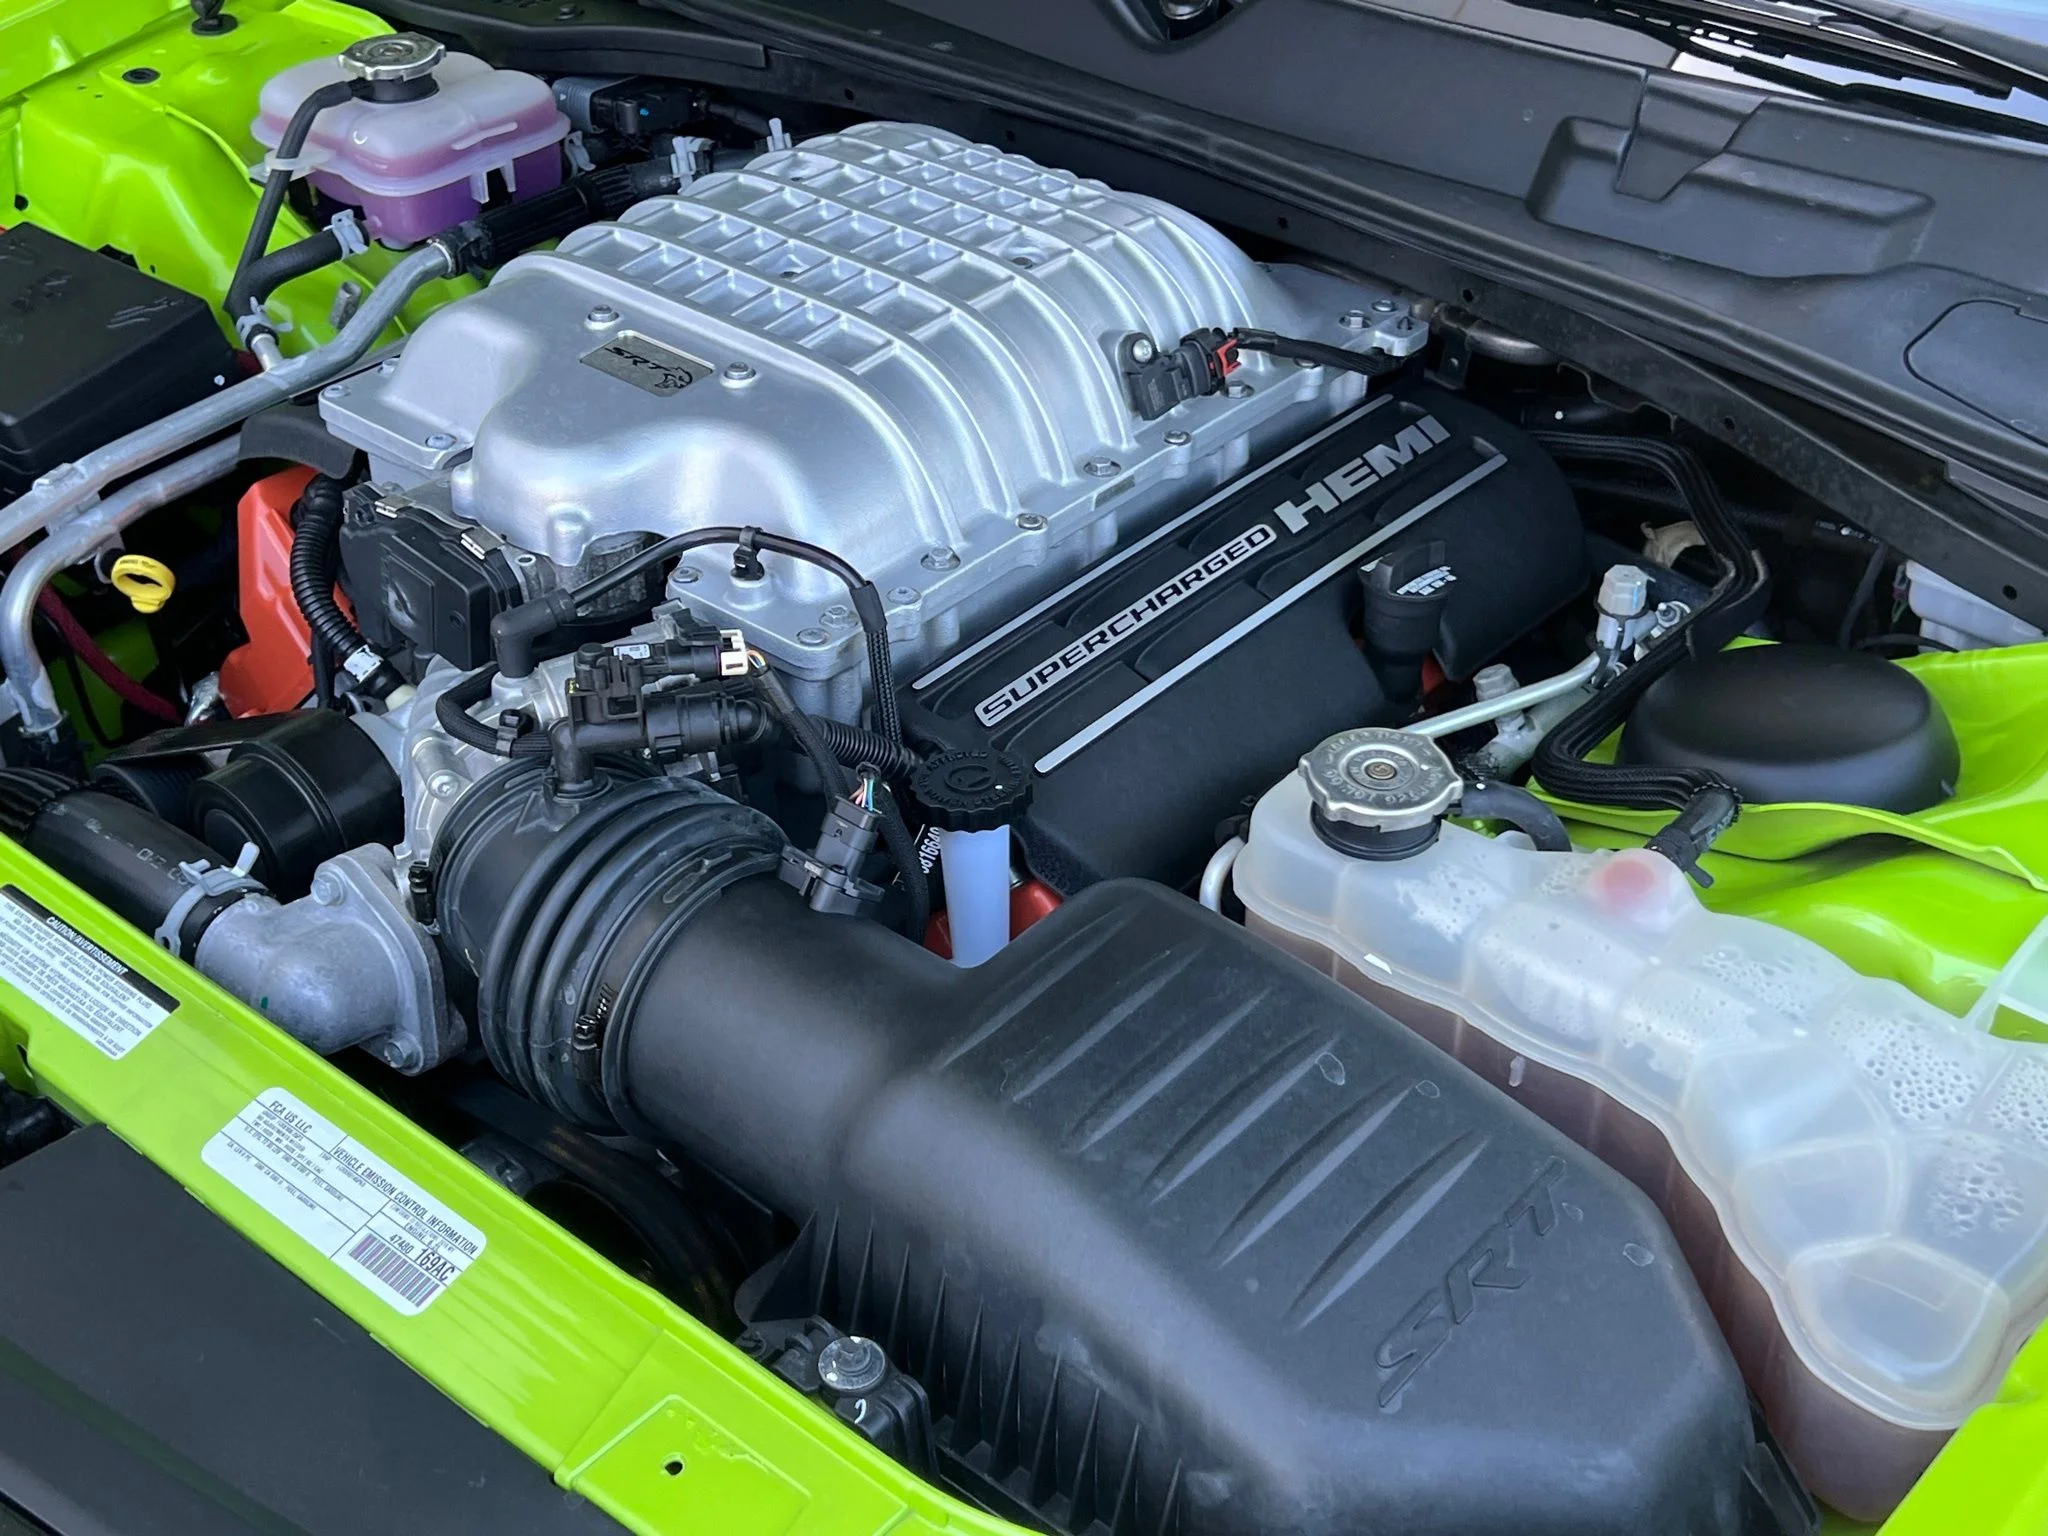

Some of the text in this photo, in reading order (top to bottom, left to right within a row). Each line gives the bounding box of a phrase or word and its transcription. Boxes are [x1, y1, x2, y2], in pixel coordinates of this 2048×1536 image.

[604, 347, 672, 372] SRT
[1273, 414, 1450, 534] HEMI
[980, 526, 1272, 722] SUPERCHARGED
[269, 1100, 284, 1116] FCA
[283, 1111, 298, 1124] US
[295, 1119, 312, 1134] LLC
[333, 1147, 365, 1173] VEHICLE
[362, 1167, 398, 1196] EMISSION
[394, 1191, 429, 1221] CONTROL
[427, 1214, 479, 1255] INFORMATION
[390, 1234, 455, 1282] 47480 169AC
[1375, 1155, 1567, 1409] SRT
